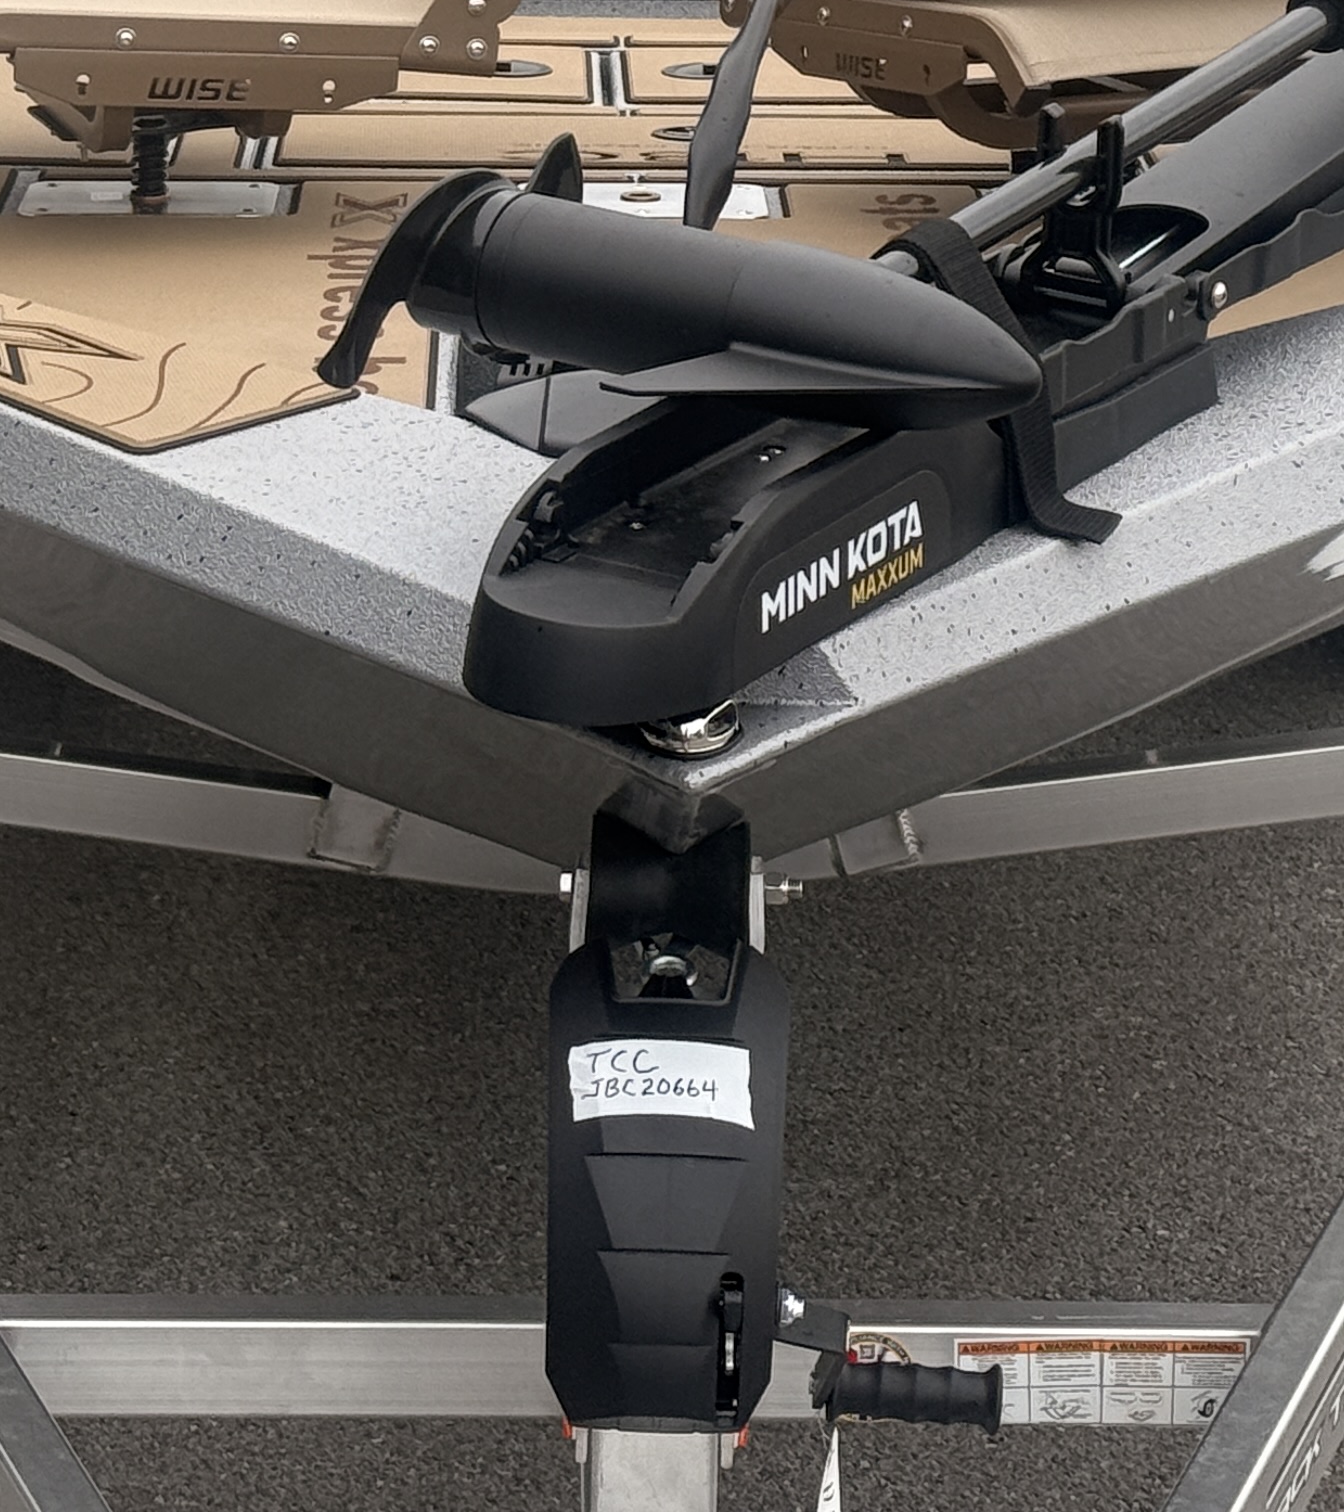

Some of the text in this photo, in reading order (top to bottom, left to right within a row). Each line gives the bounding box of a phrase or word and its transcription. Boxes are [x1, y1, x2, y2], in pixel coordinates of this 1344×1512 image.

[147, 77, 250, 101] WISE
[761, 500, 923, 634] MINN KOTA
[851, 542, 924, 610] MAXXUM
[587, 1048, 659, 1074] TCC
[581, 1077, 719, 1101] JBC20664
